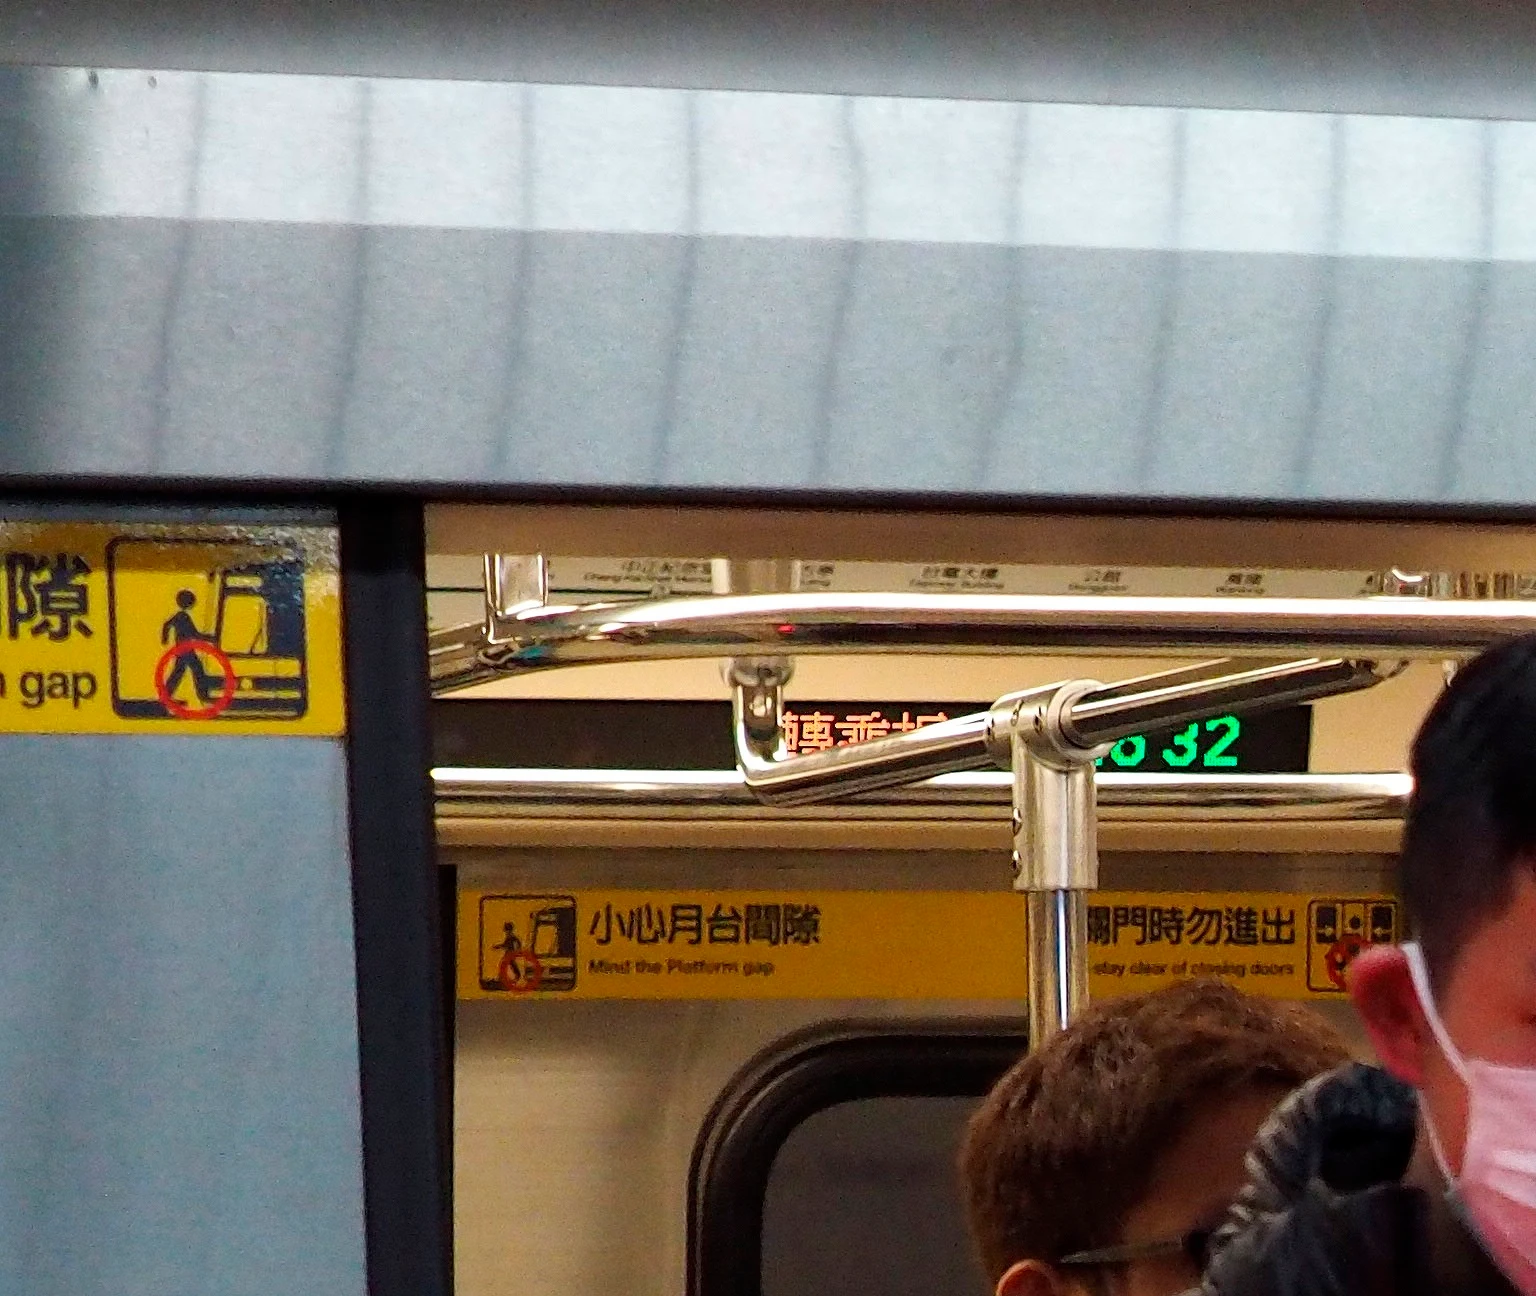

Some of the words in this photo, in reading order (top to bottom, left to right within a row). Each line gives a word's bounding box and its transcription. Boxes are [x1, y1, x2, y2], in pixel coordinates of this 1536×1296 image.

[0, 551, 94, 642] 隙
[20, 671, 97, 708] gap
[1161, 714, 1241, 767] 32
[588, 901, 822, 947] 小心月台間隙
[1087, 905, 1297, 946] 關門時勿進出
[588, 958, 631, 974] Mind
[635, 958, 662, 974] the
[666, 957, 739, 974] Platform
[743, 961, 776, 977] gap
[1129, 961, 1168, 975] clear
[1171, 961, 1188, 975] of
[1250, 961, 1295, 976] doors
